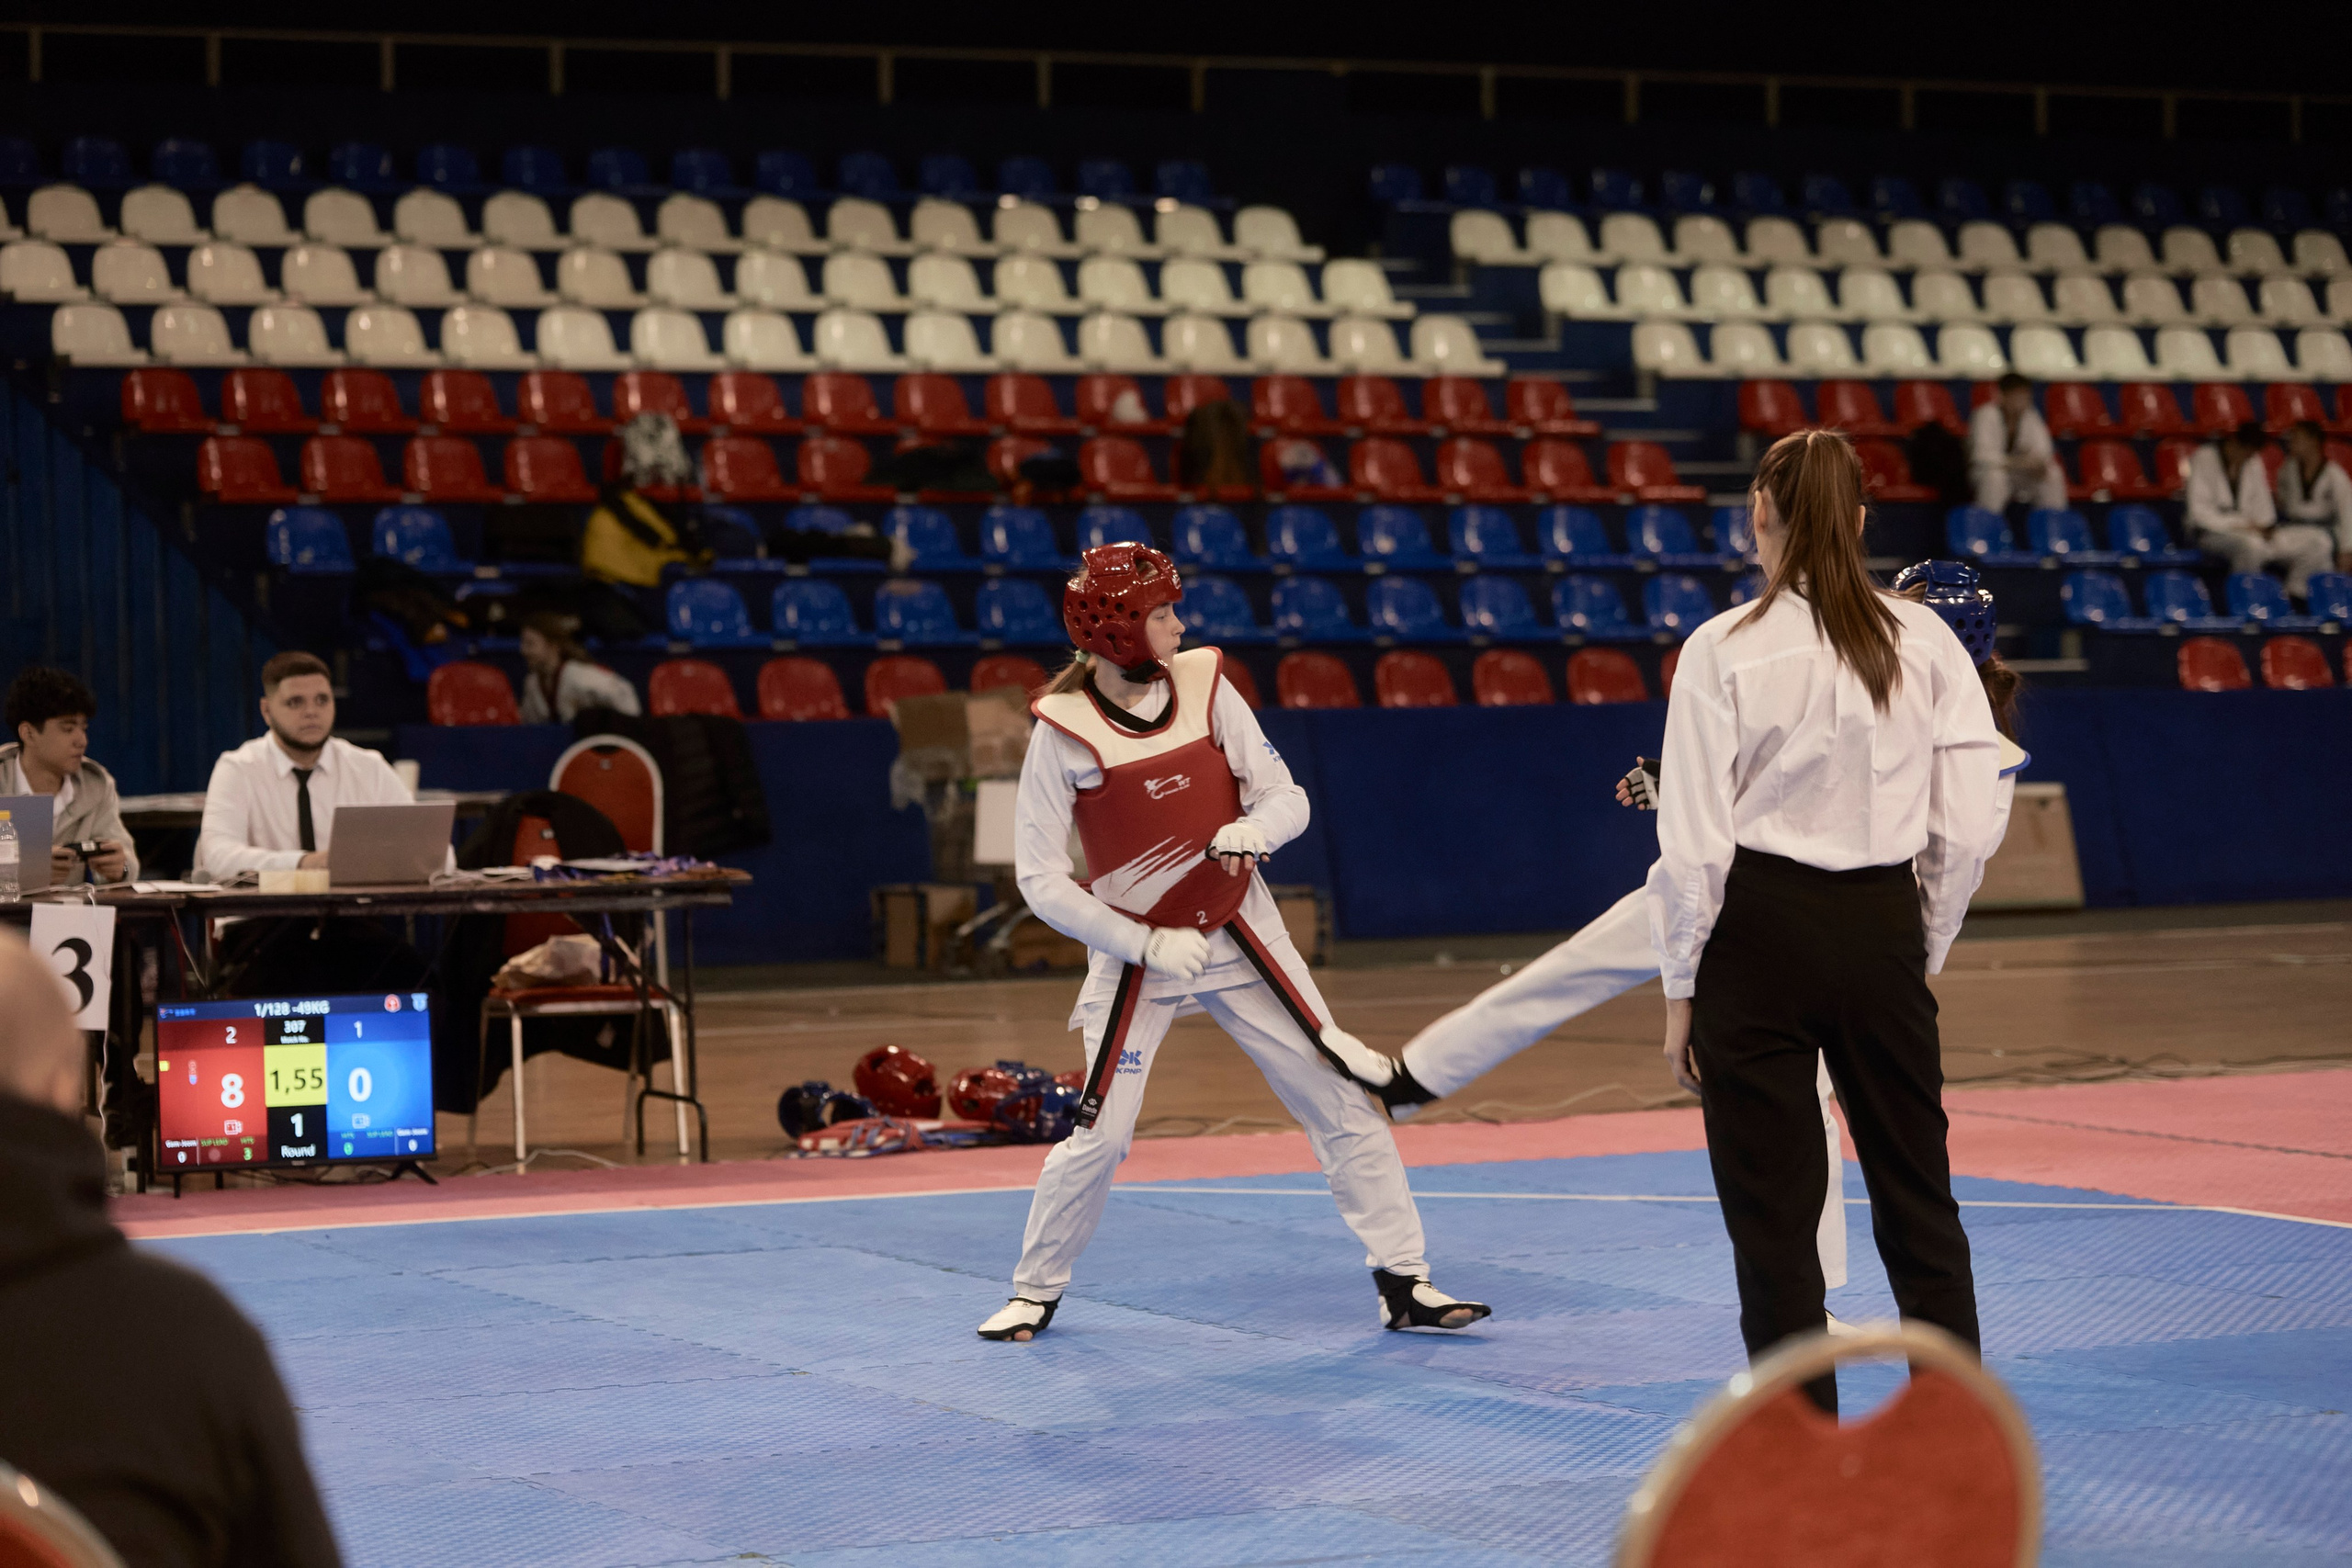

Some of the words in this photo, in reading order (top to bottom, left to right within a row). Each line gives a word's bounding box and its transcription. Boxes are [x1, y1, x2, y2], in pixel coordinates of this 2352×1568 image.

[1196, 910, 1208, 925] 2
[52, 937, 95, 1015] 3
[254, 1001, 290, 1018] 1/128
[225, 1026, 237, 1044] 2
[283, 1020, 307, 1033] 307
[354, 1021, 363, 1039] 1
[1115, 1066, 1142, 1075] KPNP
[220, 1073, 244, 1109] 8
[348, 1066, 372, 1102] 0
[290, 1112, 303, 1138] 1
[177, 1150, 187, 1164] 0
[243, 1146, 253, 1161] 3
[280, 1144, 317, 1158] Round
